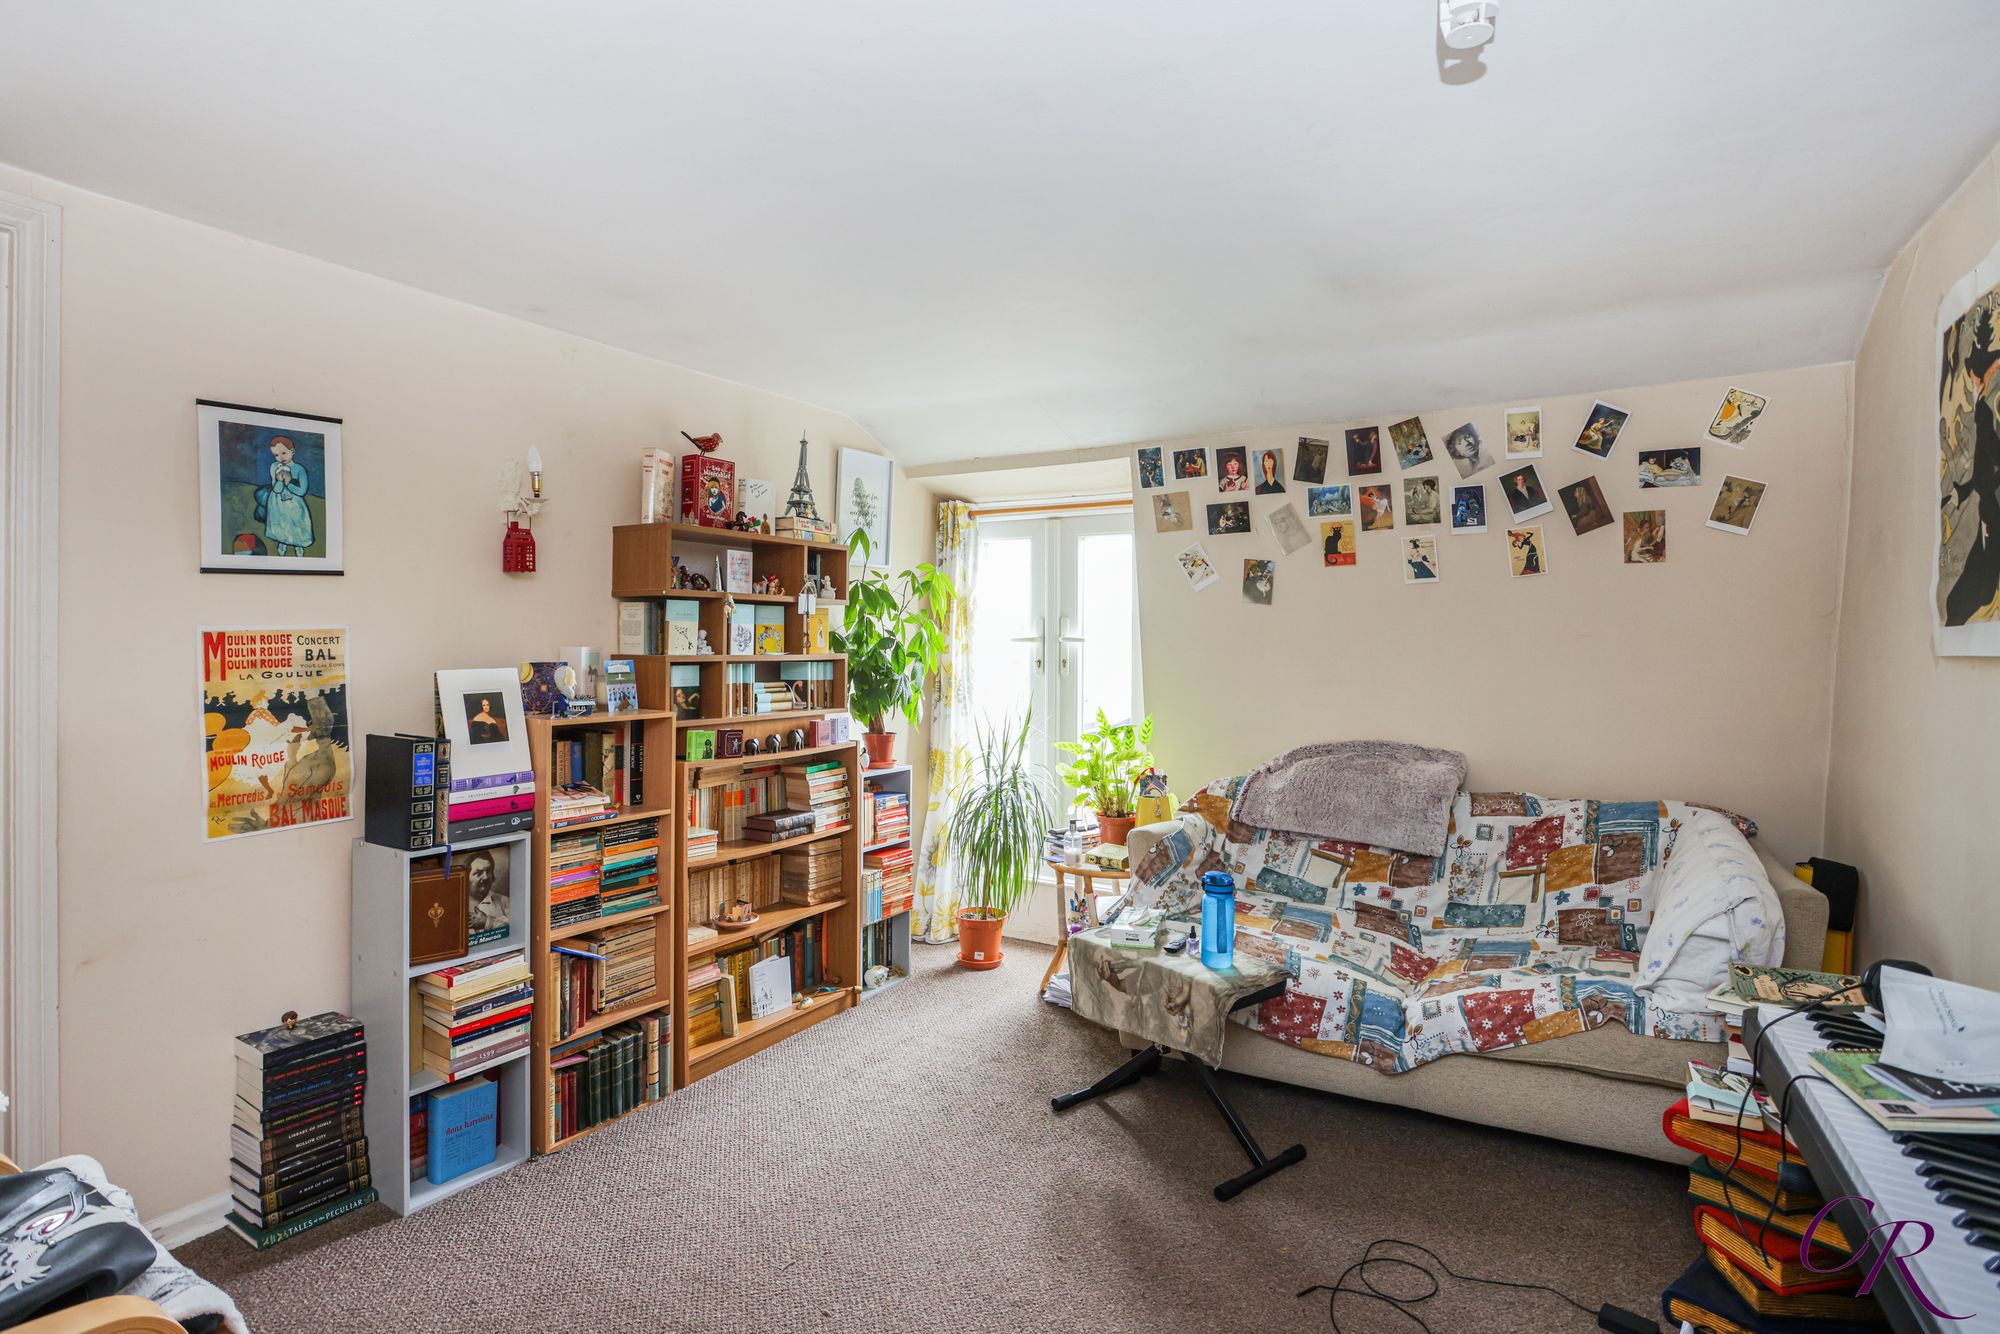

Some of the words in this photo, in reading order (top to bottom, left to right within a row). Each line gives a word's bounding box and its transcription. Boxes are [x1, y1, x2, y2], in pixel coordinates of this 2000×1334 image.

[260, 633, 293, 645] ROUGE
[260, 646, 293, 657] ROUGE
[305, 648, 336, 661] BAL
[260, 657, 293, 669] ROUGE
[261, 670, 323, 679] GOULUE
[210, 755, 248, 772] MOULIN
[251, 750, 285, 769] ROUGE
[217, 789, 265, 809] Mercredis
[287, 780, 344, 798] Samedis
[269, 802, 297, 828] BAL
[479, 1049, 495, 1059] 1599
[288, 1128, 309, 1140] LIBRARY
[295, 1137, 316, 1148] HOLLOW
[316, 1133, 327, 1142] CITY
[287, 1219, 315, 1236] TALES
[325, 1198, 363, 1221] PECULIAR
